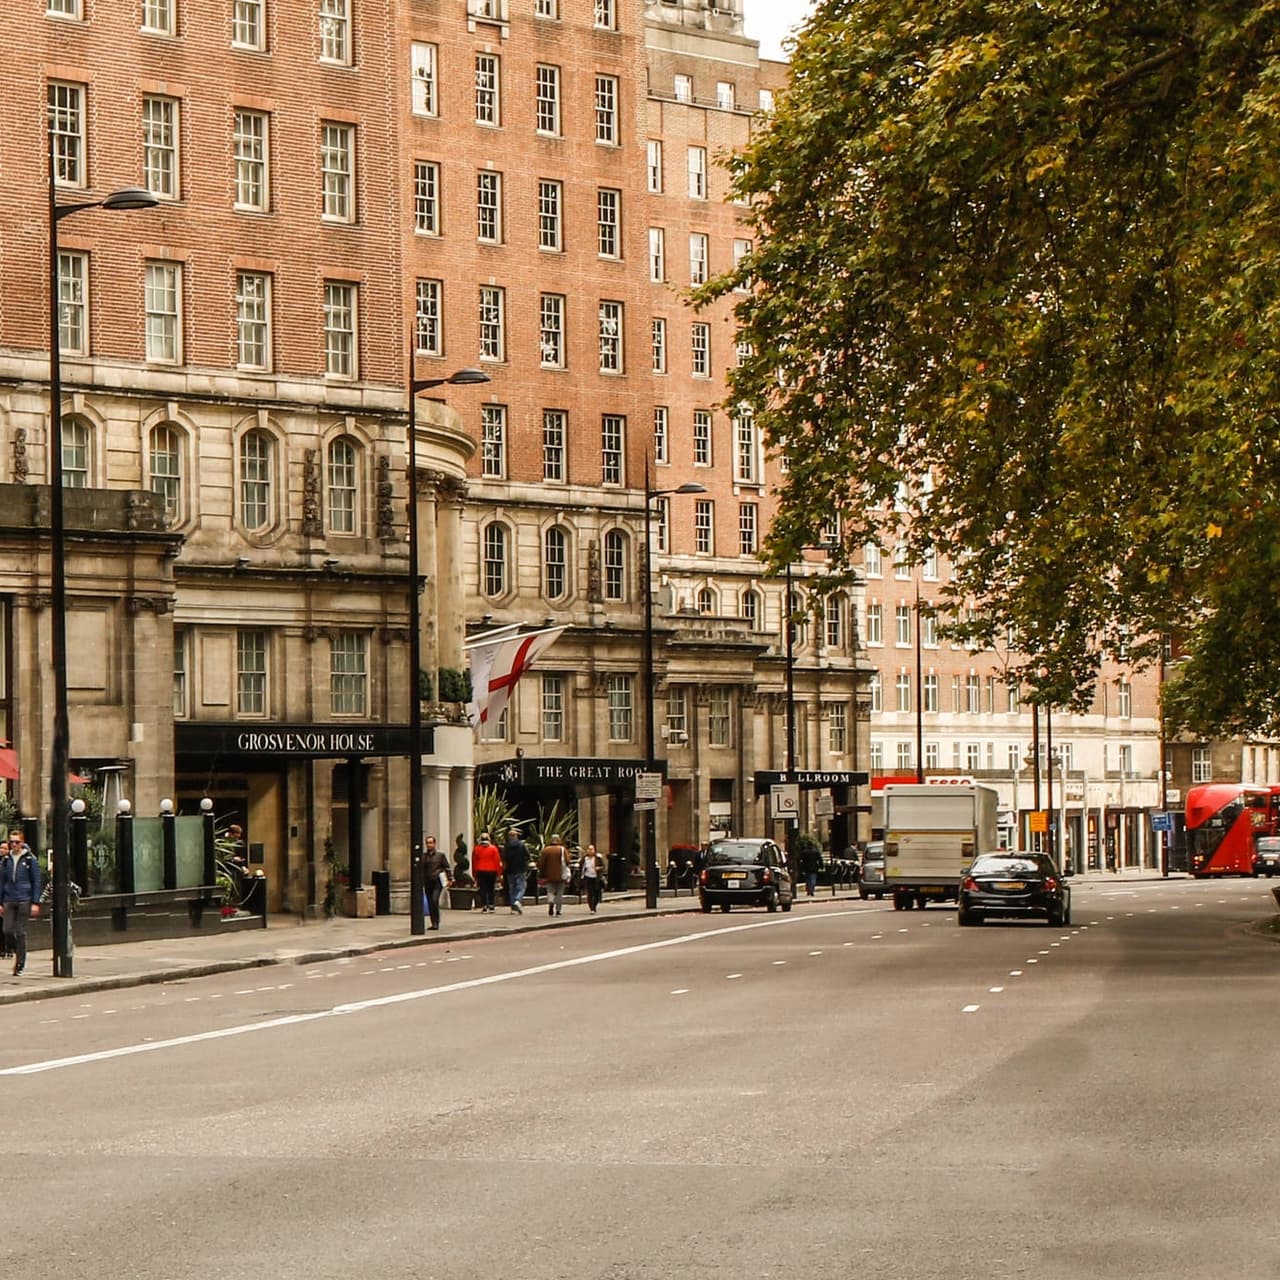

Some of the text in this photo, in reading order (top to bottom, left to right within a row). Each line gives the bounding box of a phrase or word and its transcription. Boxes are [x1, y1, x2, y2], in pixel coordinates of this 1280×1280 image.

[238, 733, 374, 751] GROSVENOR HOUSE
[537, 766, 648, 779] THE GREAT ROO
[780, 773, 849, 782] BLLROOM
